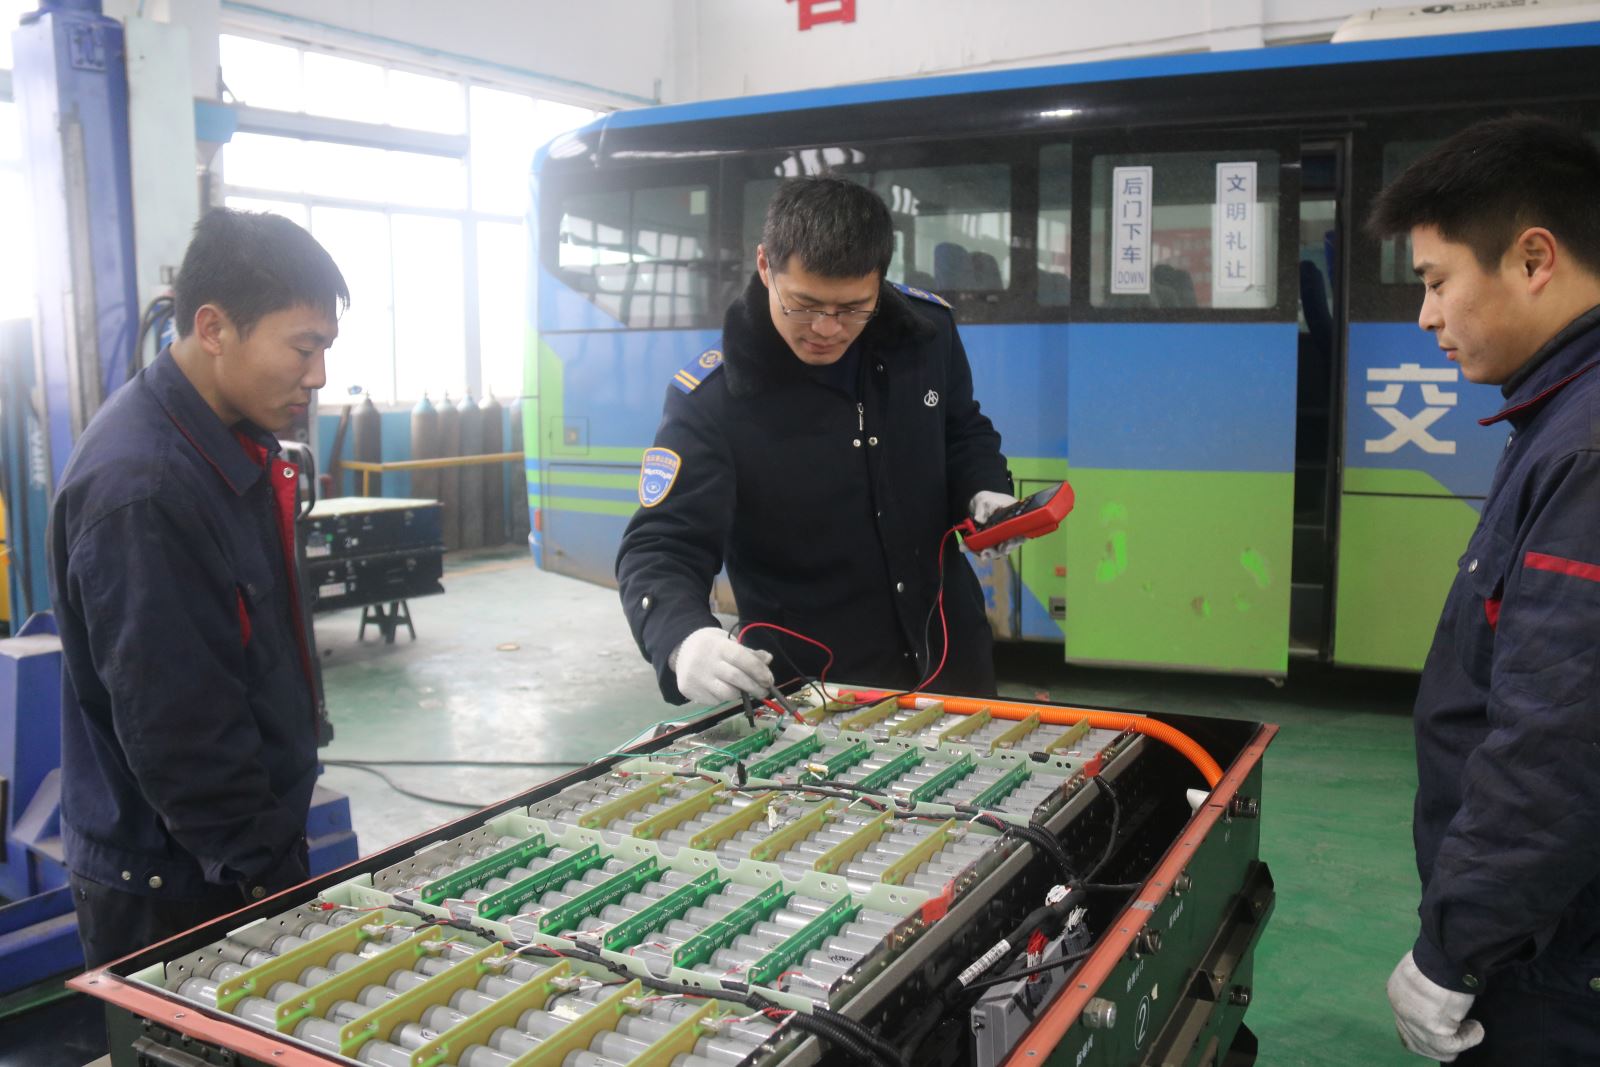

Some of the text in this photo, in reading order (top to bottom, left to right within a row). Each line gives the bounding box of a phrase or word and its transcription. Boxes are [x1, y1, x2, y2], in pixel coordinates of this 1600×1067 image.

[1122, 177, 1144, 264] 后门下车
[1225, 174, 1247, 280] 文明礼让
[1117, 271, 1145, 284] DOWN
[1365, 363, 1458, 454] 交
[1137, 1001, 1147, 1047] 2
